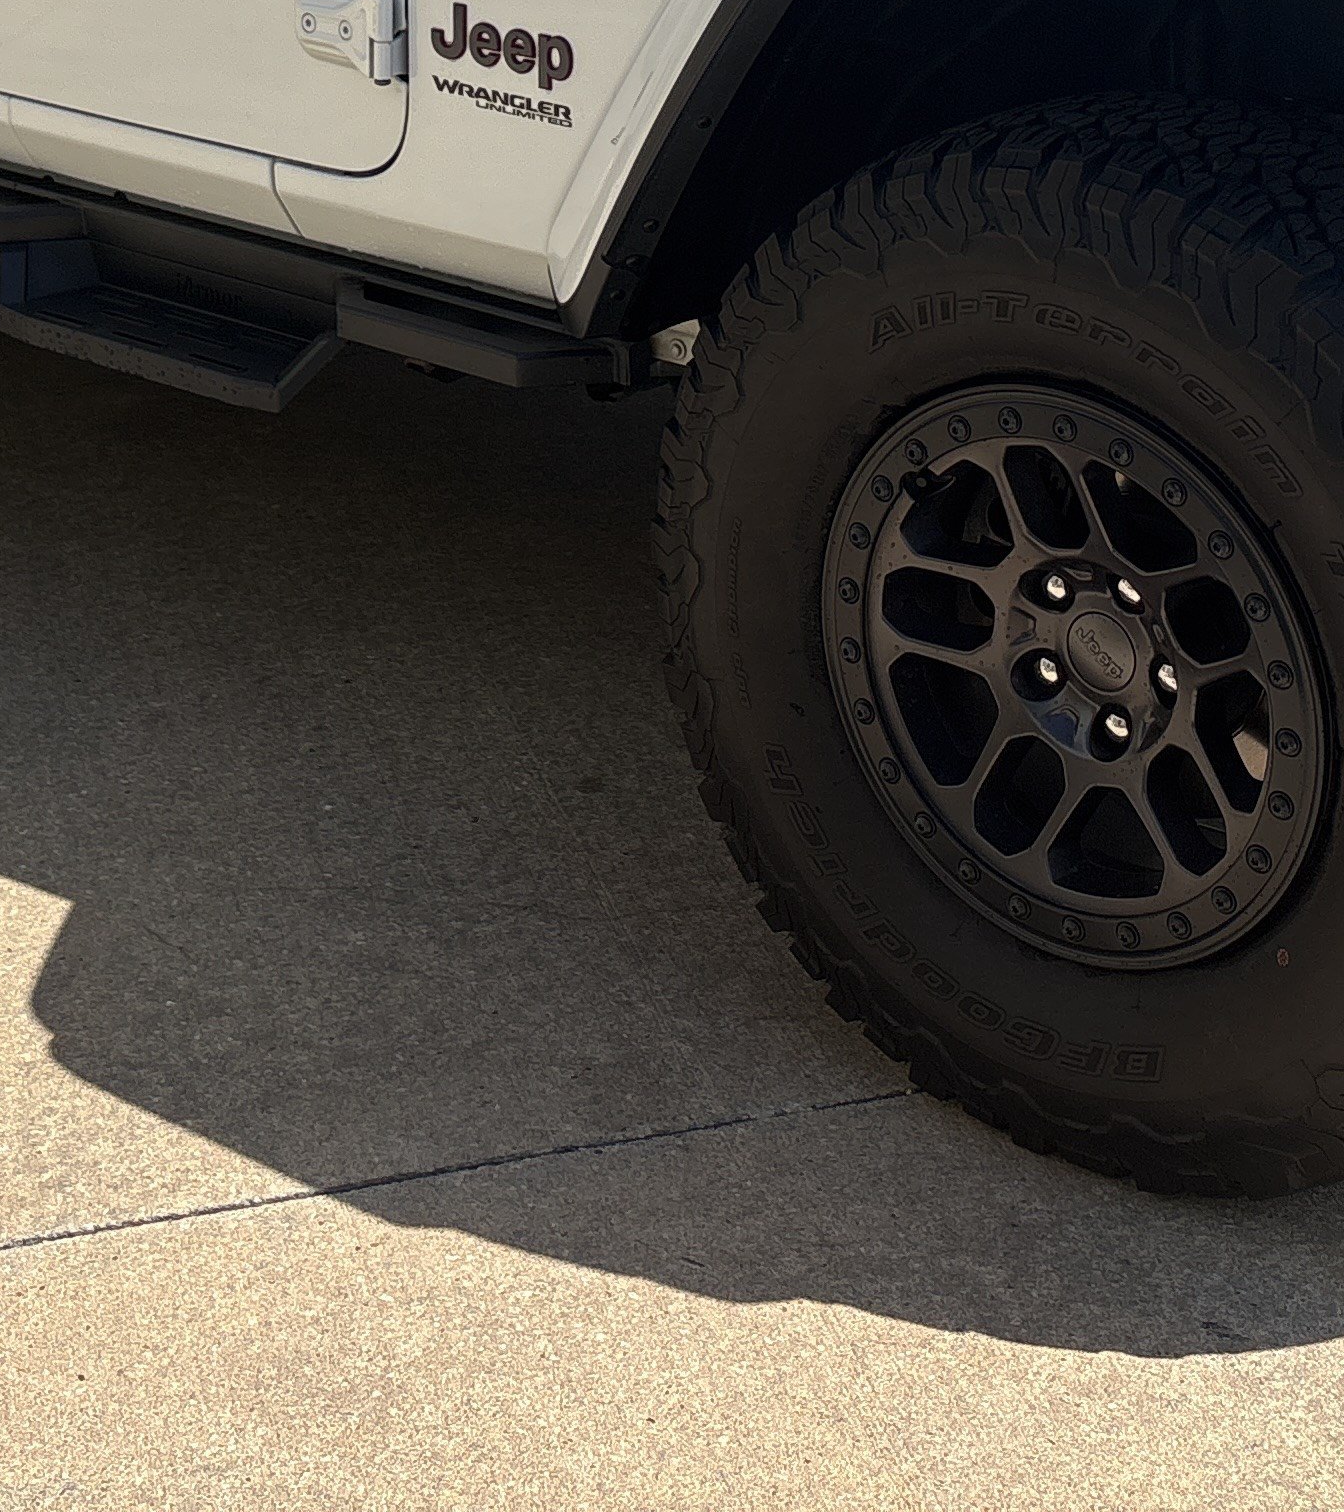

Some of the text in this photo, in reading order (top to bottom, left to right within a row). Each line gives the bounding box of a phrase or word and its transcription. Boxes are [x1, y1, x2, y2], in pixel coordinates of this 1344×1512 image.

[430, 2, 574, 91] Jeep
[431, 74, 573, 121] WRANGLER
[475, 101, 573, 129] UNLIMITED
[864, 288, 1304, 499] All-Terrain
[1075, 625, 1125, 680] Jeep
[761, 740, 1168, 1087] BFGoodrich
